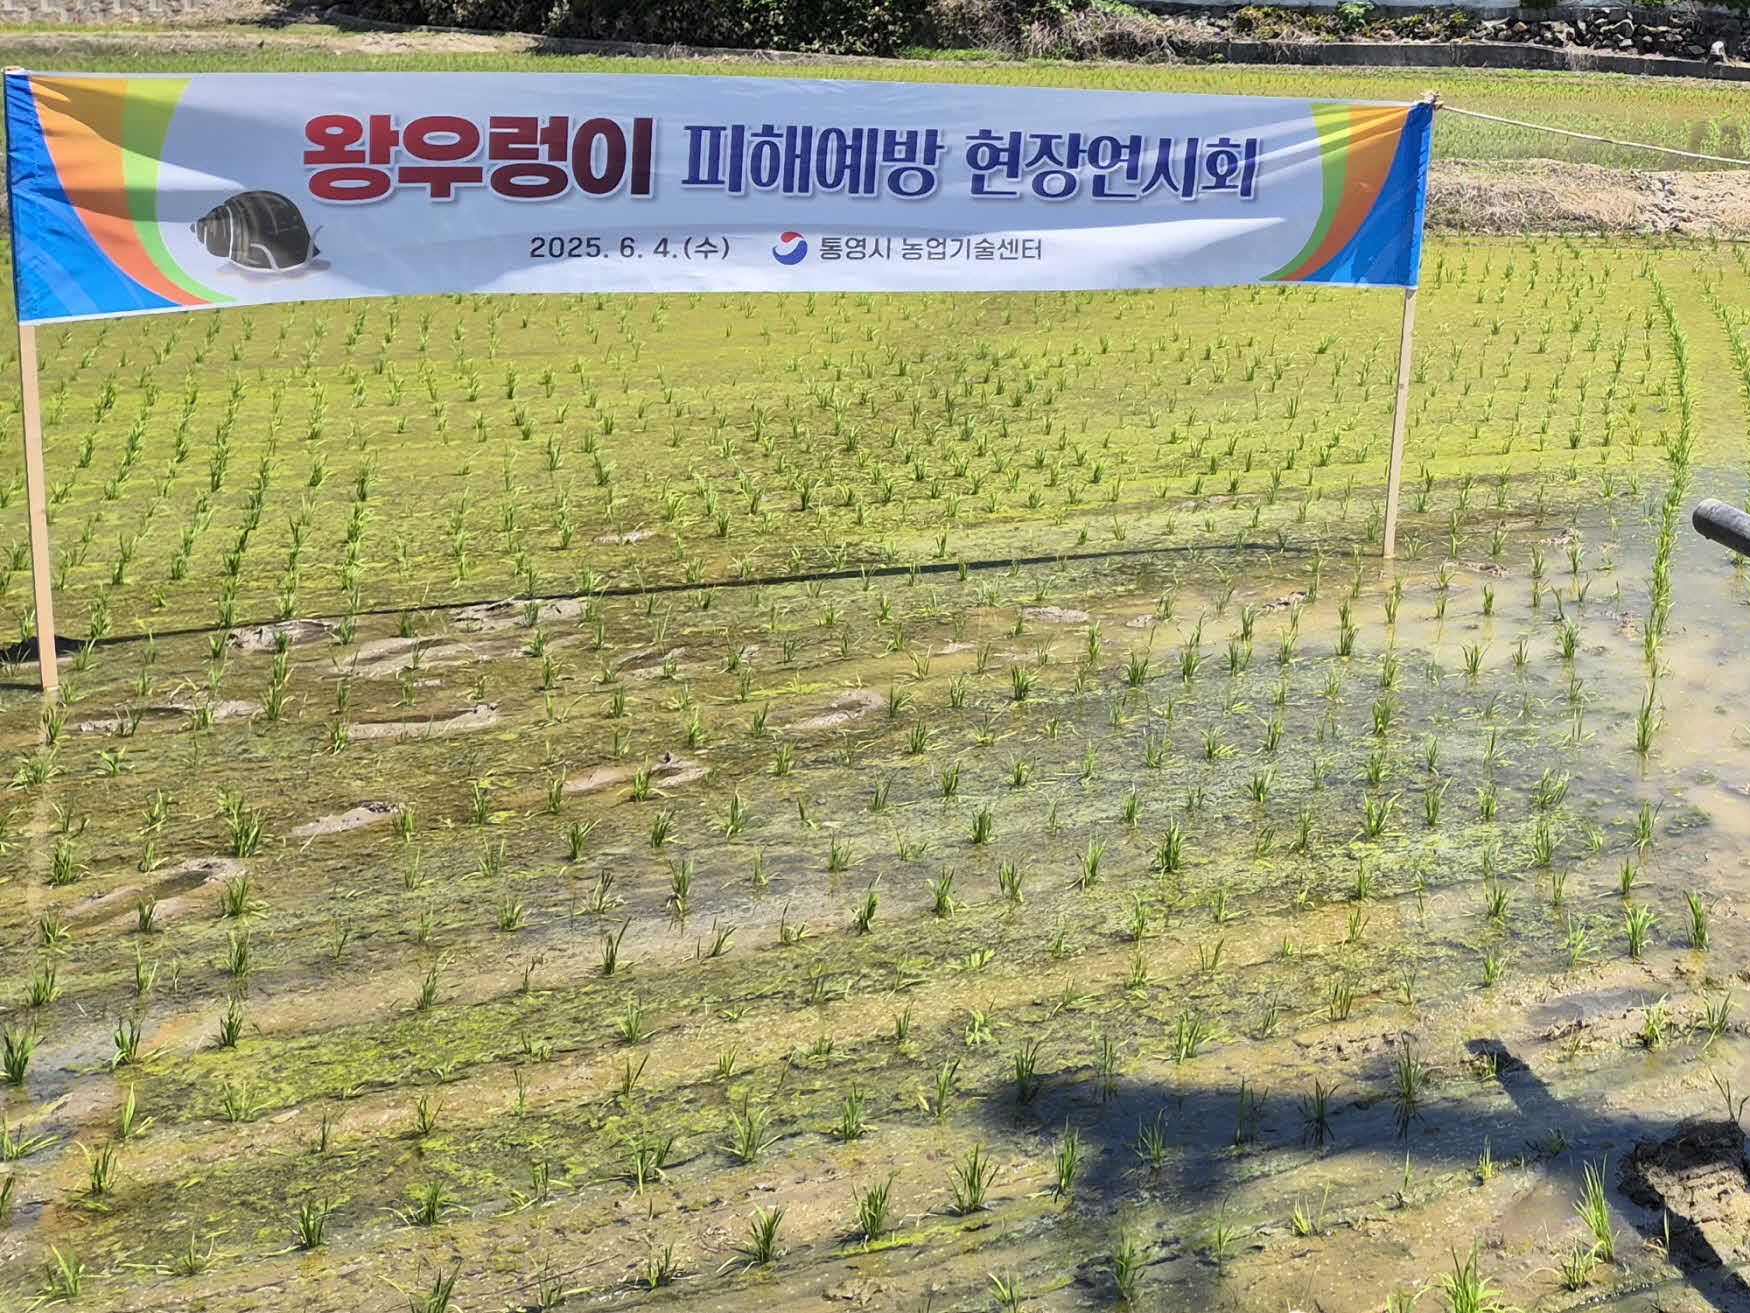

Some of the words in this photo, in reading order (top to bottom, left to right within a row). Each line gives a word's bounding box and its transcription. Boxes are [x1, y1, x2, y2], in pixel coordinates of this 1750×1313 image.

[304, 114, 652, 201] 왕우렁이
[681, 124, 946, 196] 피해예방
[966, 129, 1257, 199] 현장연시회
[530, 237, 609, 258] 2025.
[619, 237, 643, 259] 6.
[653, 237, 730, 260] 4.(수)
[820, 237, 892, 260] 통영시
[901, 237, 1042, 261] 농업기술센터
